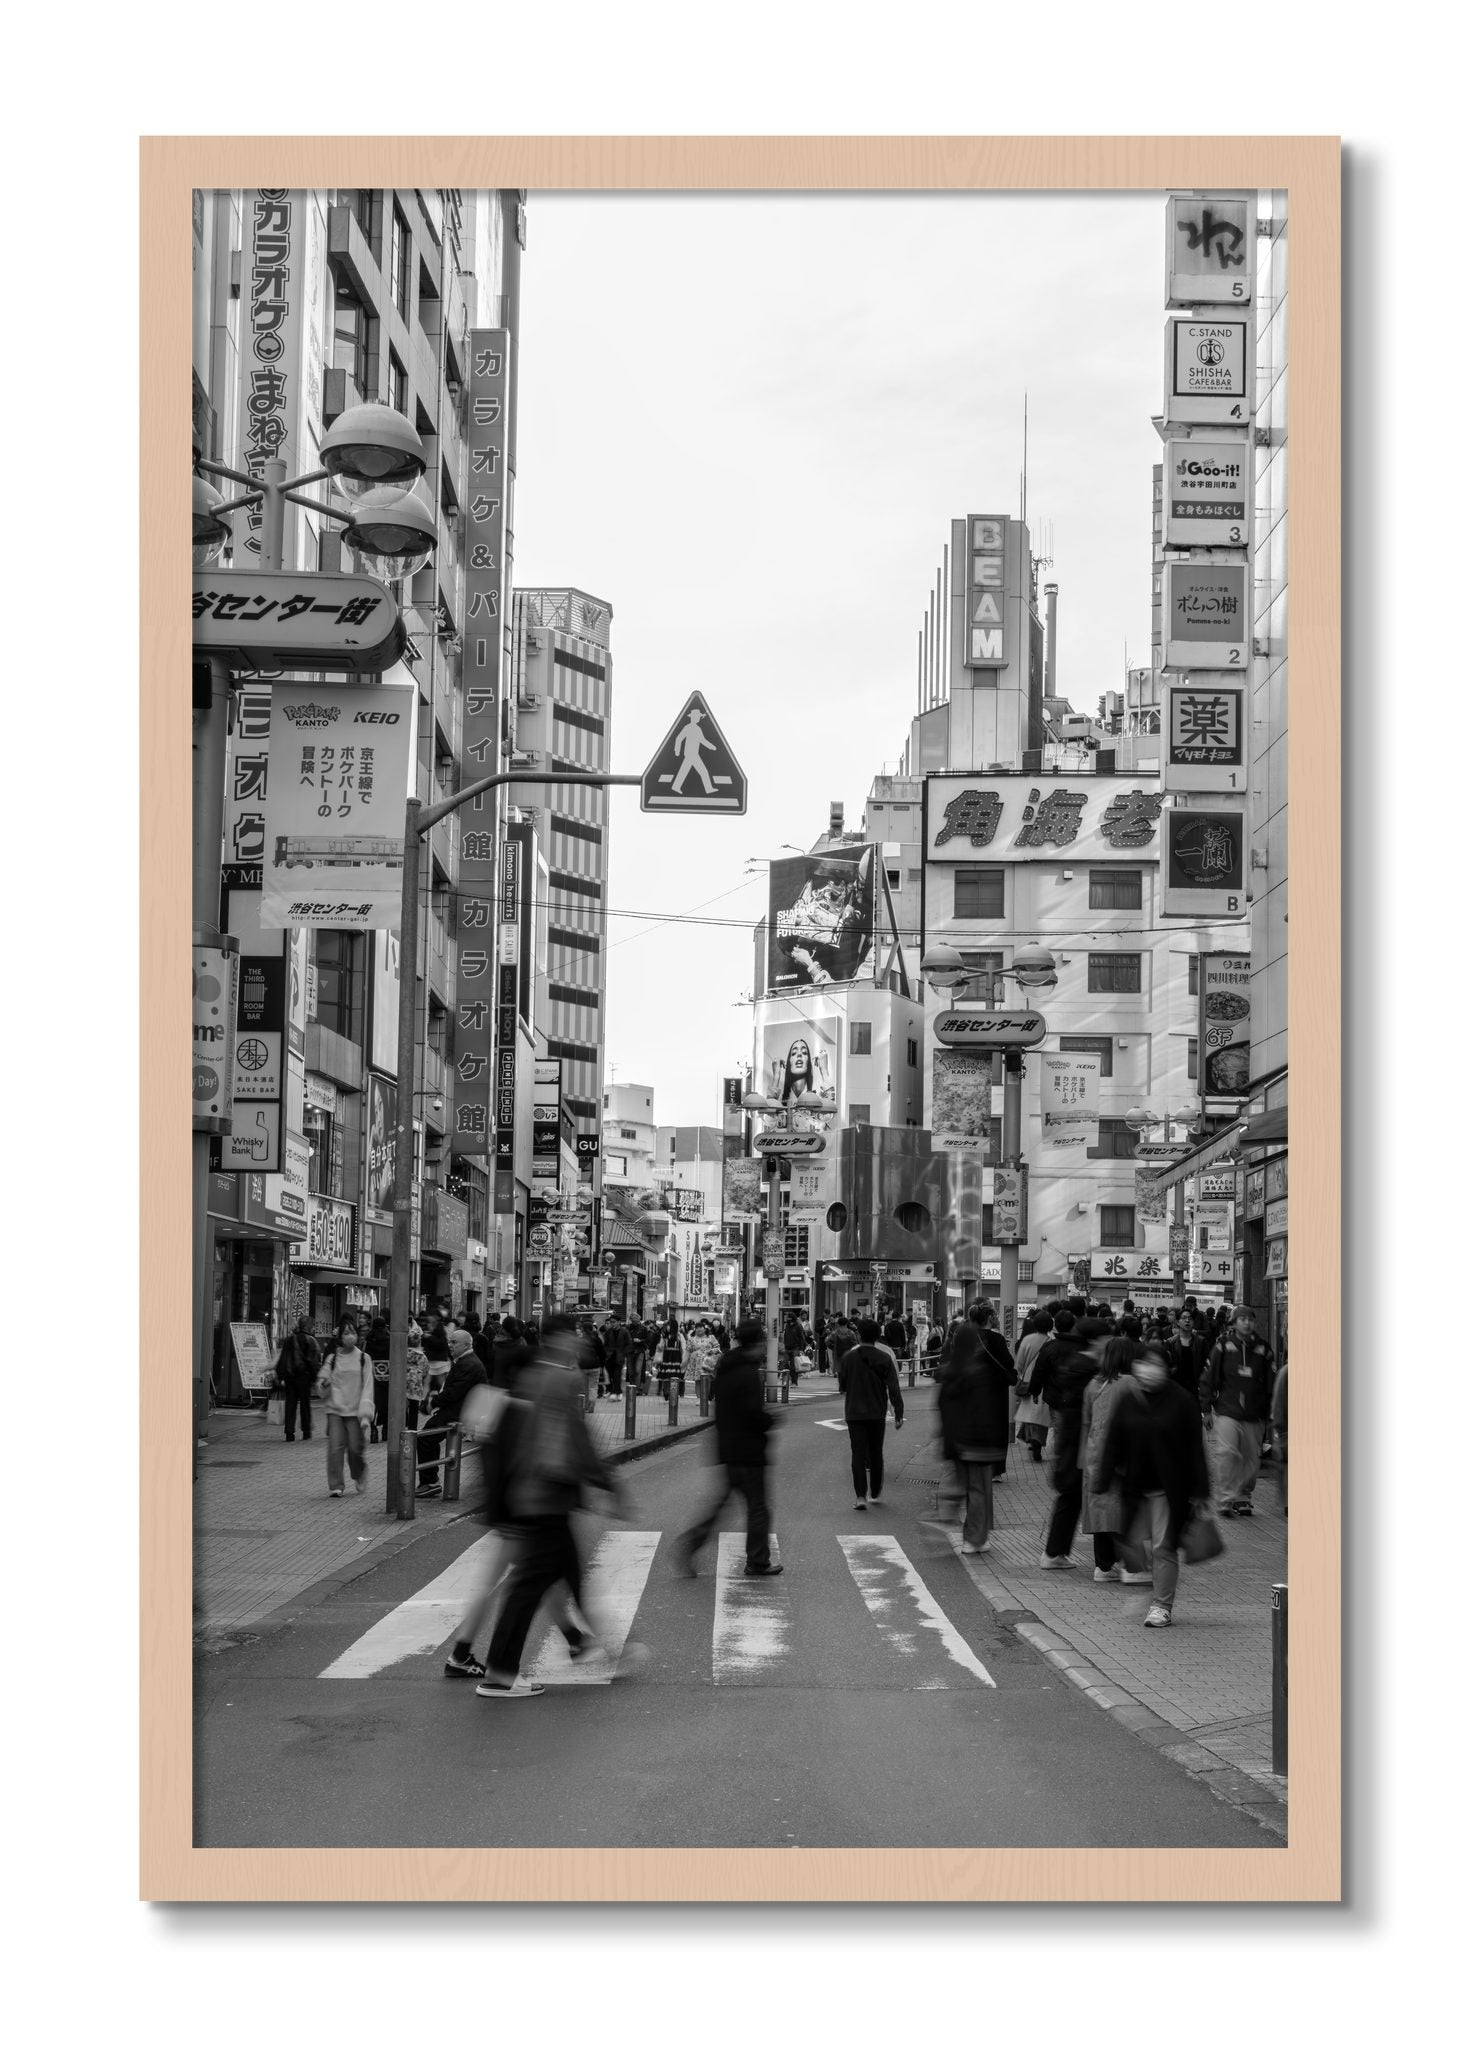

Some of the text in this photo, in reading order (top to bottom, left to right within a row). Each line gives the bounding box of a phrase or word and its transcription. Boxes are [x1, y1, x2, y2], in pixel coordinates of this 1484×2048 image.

[251, 201, 291, 334] カラオケ
[1231, 282, 1244, 298] 5
[1188, 328, 1233, 338] C.STAND
[1188, 367, 1232, 378] SHISHA
[1188, 378, 1232, 386] CAFE&BAR
[1230, 404, 1242, 419] 4
[1187, 461, 1240, 477] Goo-it!
[1176, 505, 1241, 516] 全身もみほぐし
[1229, 526, 1242, 543] 3
[972, 521, 1004, 659] BEAM
[1177, 594, 1239, 615] ポムの樹
[1186, 617, 1231, 625] Pomme-no-ki
[1229, 648, 1241, 665] 2
[295, 719, 329, 727] KANTO
[353, 711, 400, 725] KEIO
[1180, 695, 1229, 746] 薬
[1174, 748, 1234, 762] マツモトキヨシ
[300, 745, 316, 788] 冒険へ
[317, 746, 335, 818] カントーの
[358, 747, 375, 805] 京王線で
[1228, 772, 1237, 788] 1
[934, 788, 1162, 847] 角海老
[1174, 826, 1233, 873] 一蘭
[506, 846, 515, 918] kimono hearts
[287, 902, 374, 915] 渋谷センター街
[1228, 896, 1240, 912] B
[244, 975, 265, 983] THIRD
[247, 968, 262, 976] THE
[1207, 972, 1250, 984] 四川料理
[243, 1002, 264, 1010] ROOM
[456, 899, 490, 1134] カラオケ館
[940, 1018, 1040, 1032] 渋谷センター街
[1206, 1027, 1234, 1048] 6F
[199, 1075, 218, 1089] Day!
[236, 1086, 257, 1094] SAKE
[232, 1136, 264, 1147] Whisky
[578, 1140, 598, 1151] GU
[231, 1146, 252, 1154] Bank
[1104, 1255, 1161, 1276] 兆楽
[692, 1253, 701, 1294] BEER
